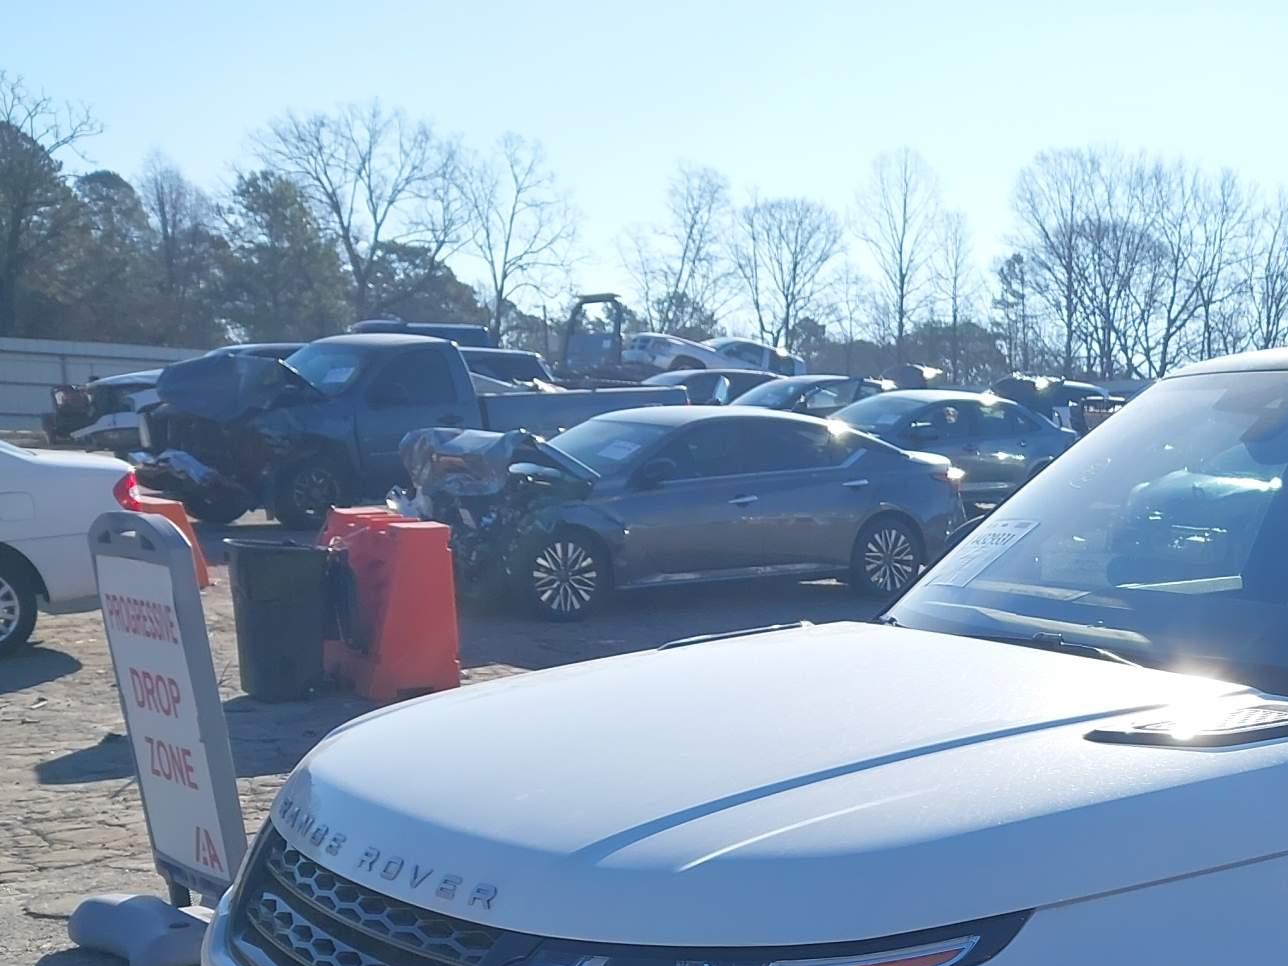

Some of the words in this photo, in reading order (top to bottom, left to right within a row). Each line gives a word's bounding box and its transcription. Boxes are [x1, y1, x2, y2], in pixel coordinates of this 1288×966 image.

[105, 593, 179, 645] PROGRESSIVE
[129, 667, 182, 719] DROP
[144, 736, 199, 790] ZONE
[279, 796, 347, 857] RANGE
[357, 846, 499, 911] ROVER
